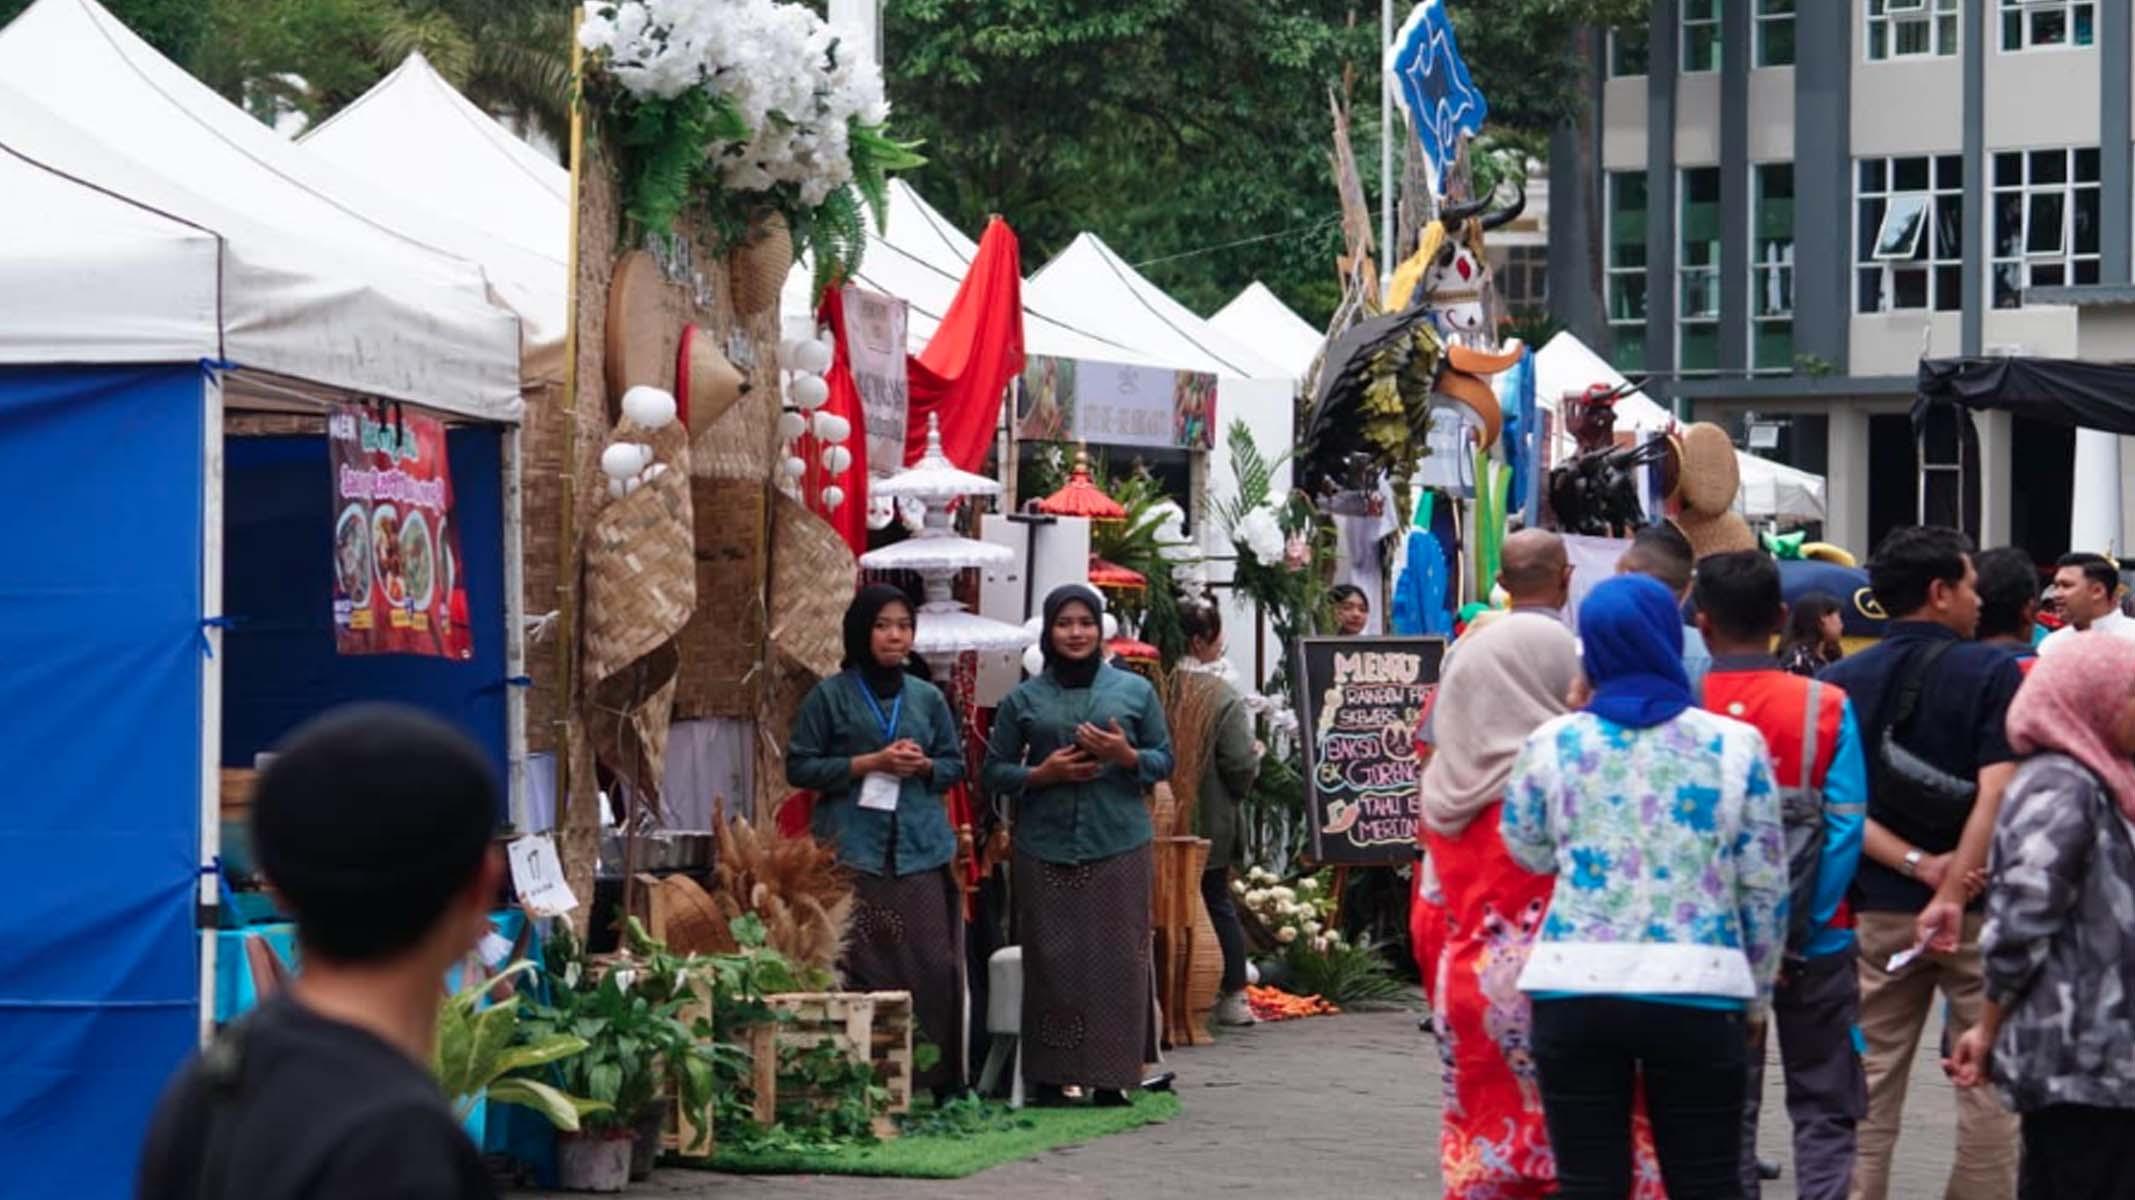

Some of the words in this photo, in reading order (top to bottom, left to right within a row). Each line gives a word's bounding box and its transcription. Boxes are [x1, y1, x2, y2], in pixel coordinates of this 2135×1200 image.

[1334, 651, 1422, 684] MENU
[1345, 687, 1405, 706] RAINBOW
[1327, 737, 1380, 760] BAKSO
[1361, 796, 1401, 818] TAHU
